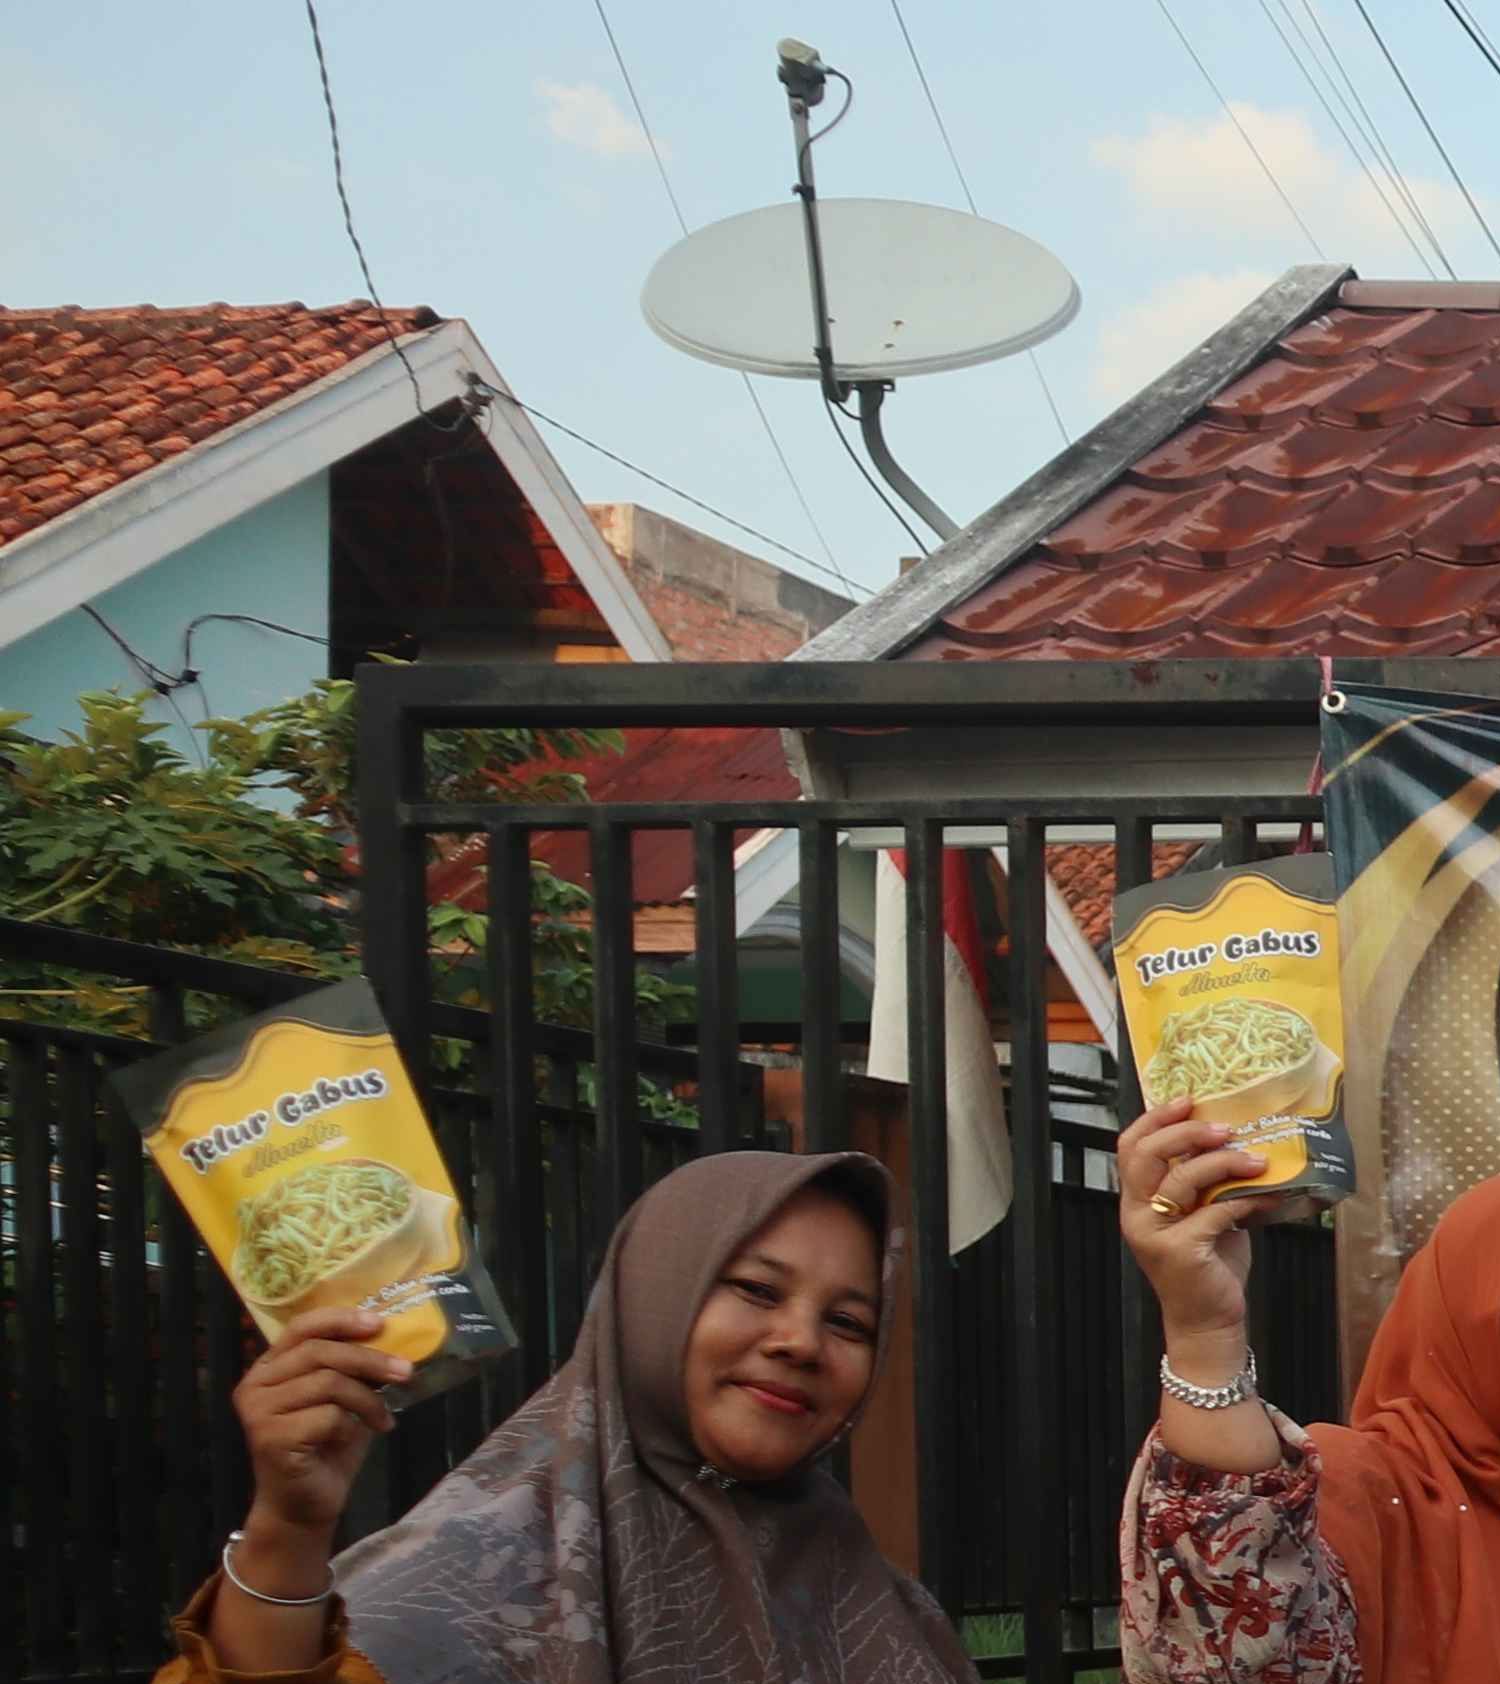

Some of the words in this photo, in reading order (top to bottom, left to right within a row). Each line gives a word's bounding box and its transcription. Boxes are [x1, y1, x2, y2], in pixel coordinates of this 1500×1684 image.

[1136, 945, 1216, 985] Telur
[1222, 929, 1320, 961] Gabus
[181, 1111, 269, 1173] Telur
[275, 1069, 387, 1126] Gabus
